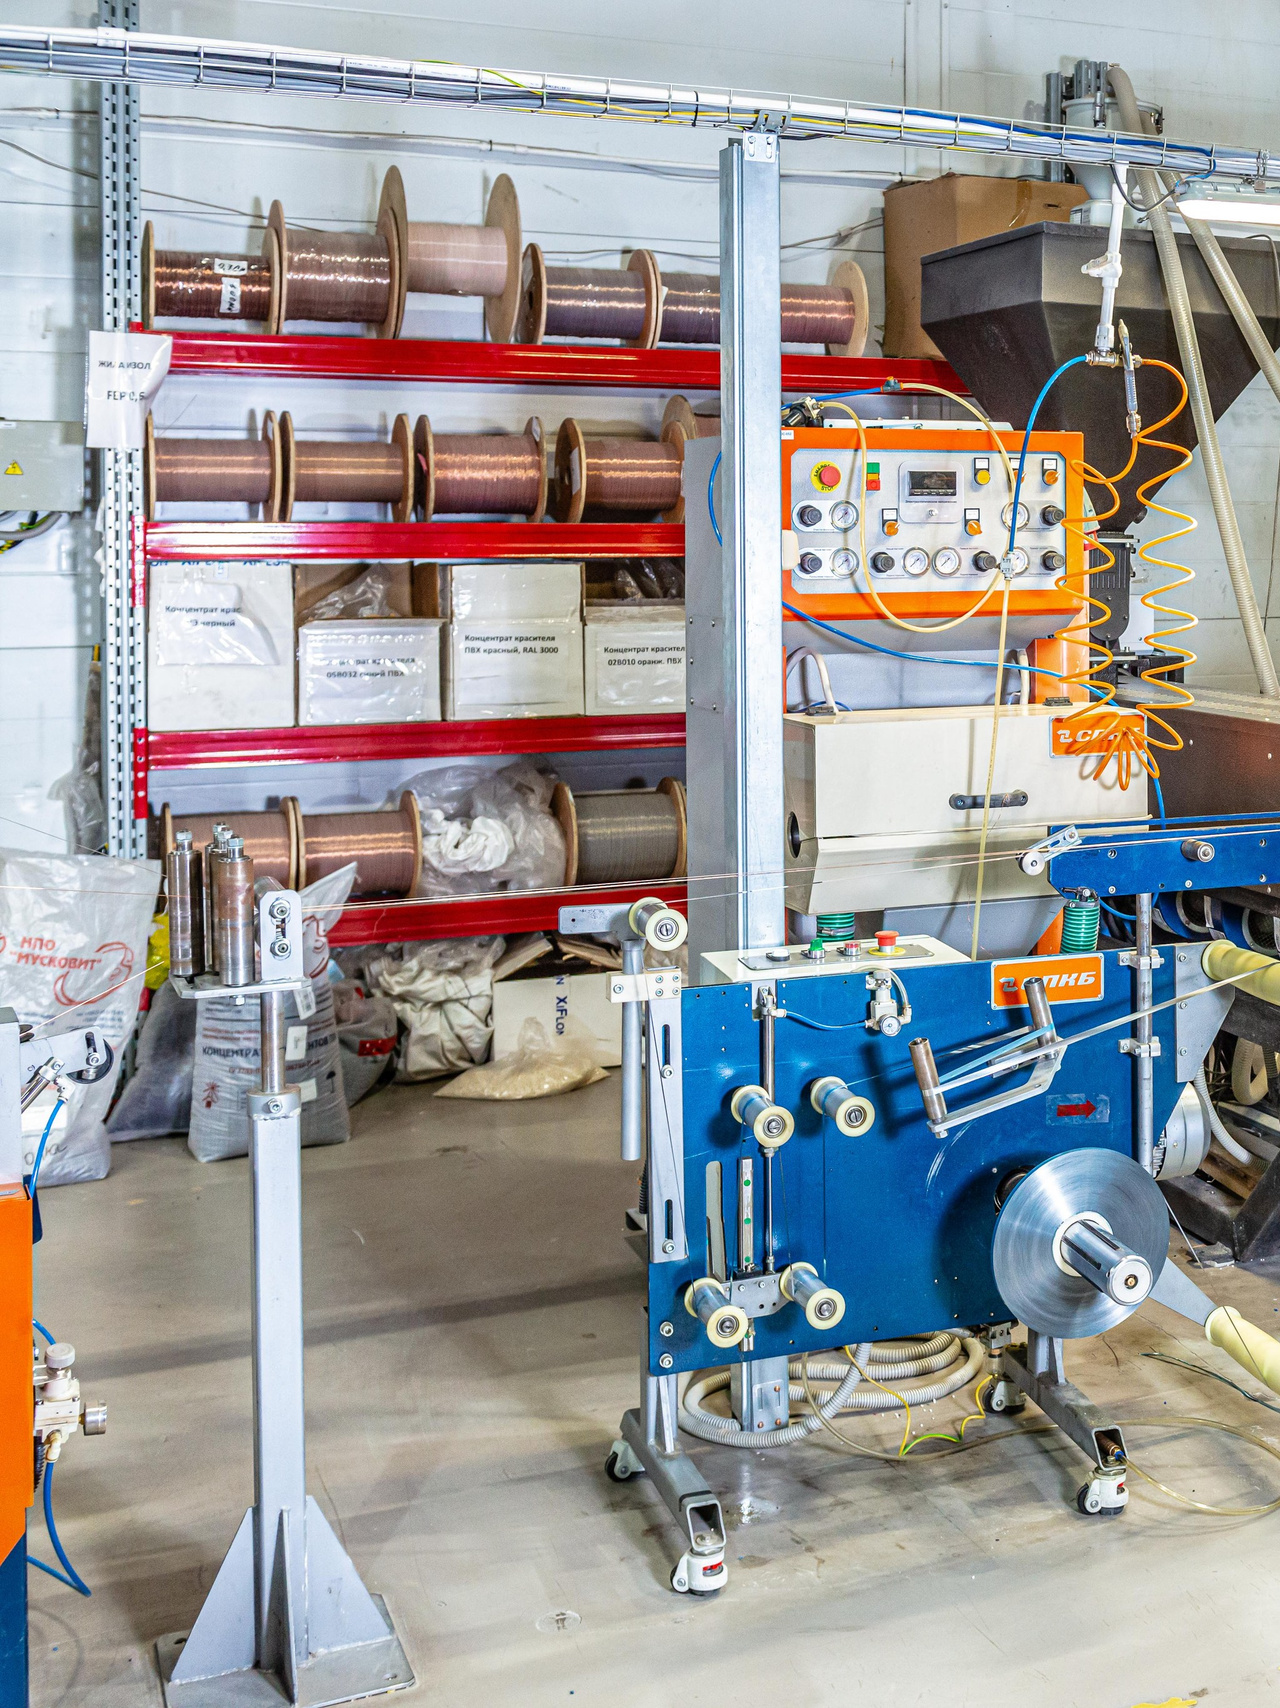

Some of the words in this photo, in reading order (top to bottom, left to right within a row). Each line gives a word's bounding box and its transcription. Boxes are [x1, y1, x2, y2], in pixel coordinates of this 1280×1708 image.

[98, 360, 125, 369] ЖИА
[464, 634, 513, 643] Концентрат
[514, 635, 556, 643] красителя
[464, 646, 481, 654] ПВХ
[482, 646, 521, 655] красный,
[522, 646, 538, 654] RAL
[539, 646, 559, 654] 3000
[604, 646, 649, 655] Концентрат
[650, 645, 686, 653] красител
[637, 659, 665, 667] оранж.
[667, 657, 683, 665] ПВХ
[20, 936, 56, 951] НПО
[202, 1046, 260, 1058] КОНЦЕНТРА
